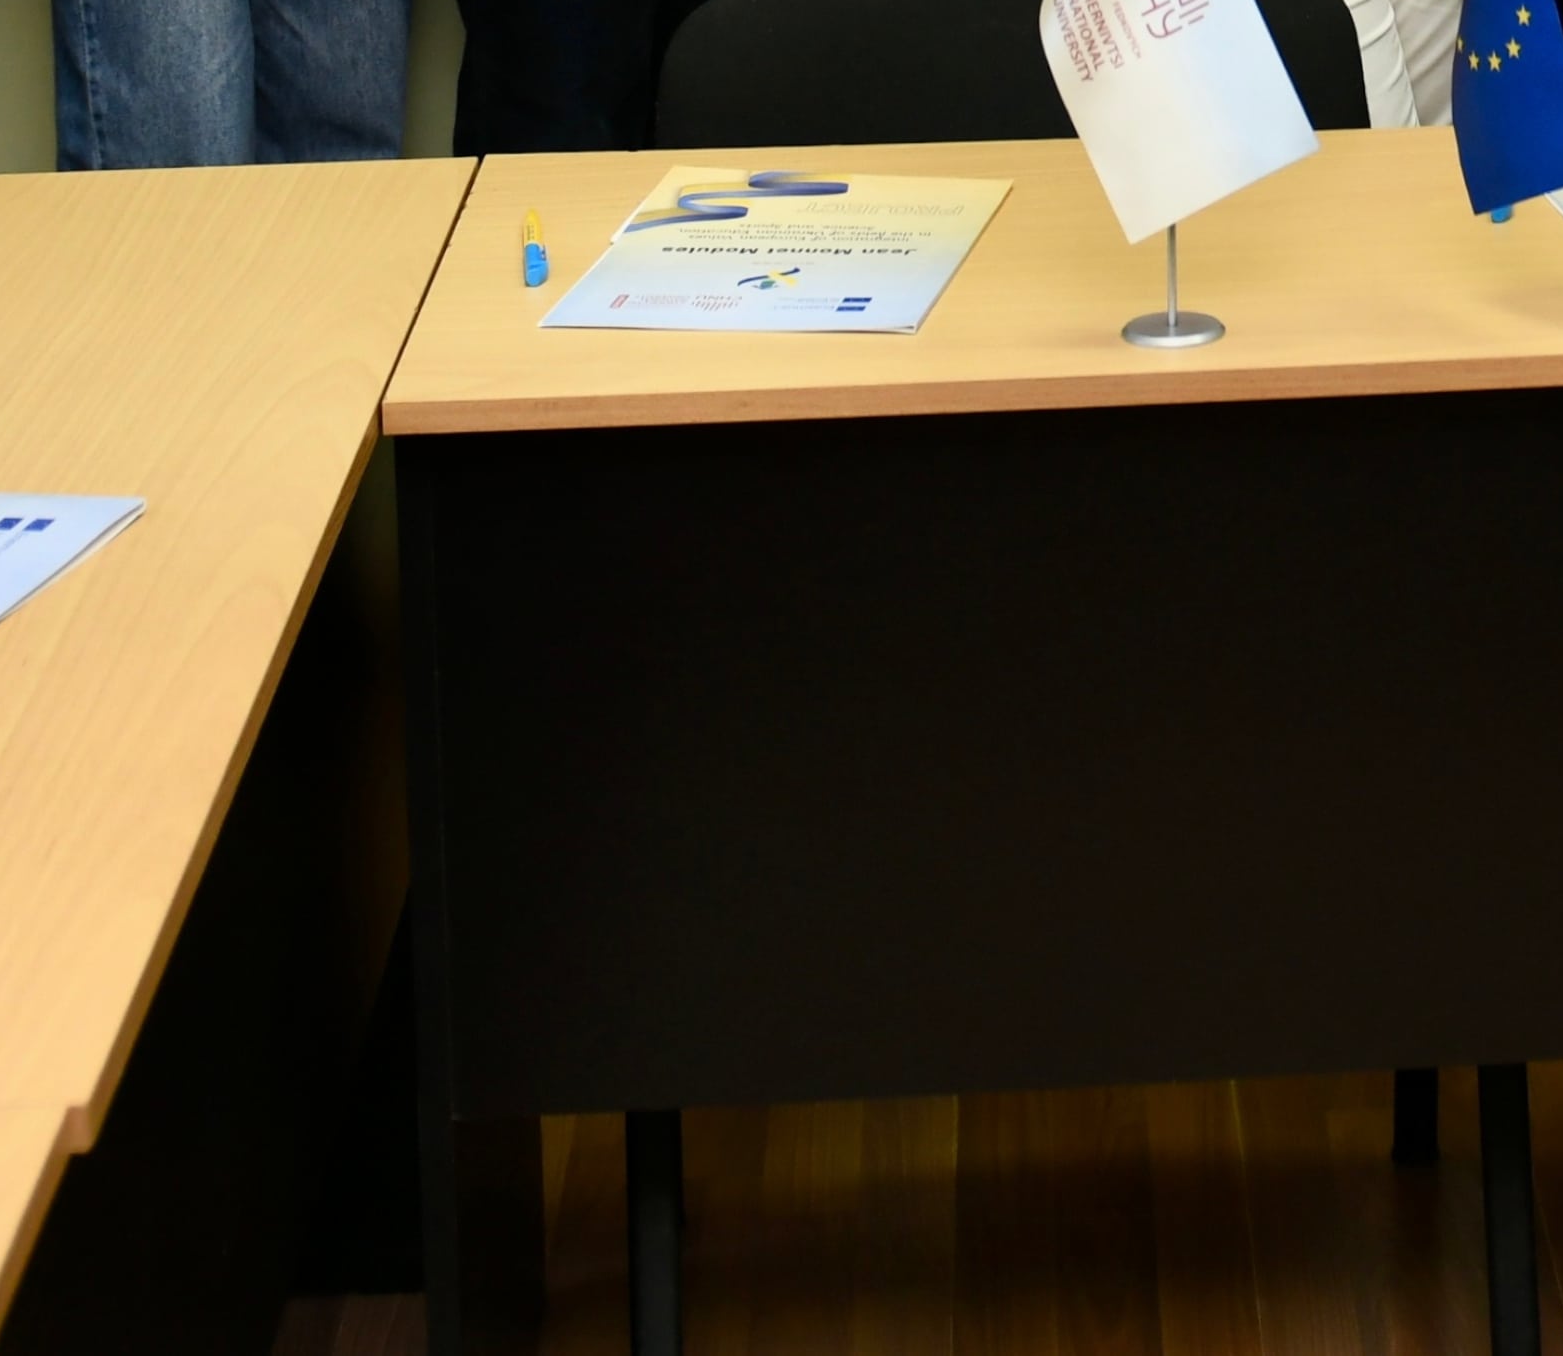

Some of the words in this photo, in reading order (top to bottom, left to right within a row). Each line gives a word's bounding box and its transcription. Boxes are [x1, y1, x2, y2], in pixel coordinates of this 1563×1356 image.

[657, 244, 761, 255] Modules
[763, 246, 854, 256] Monnet
[858, 247, 918, 256] Jean
